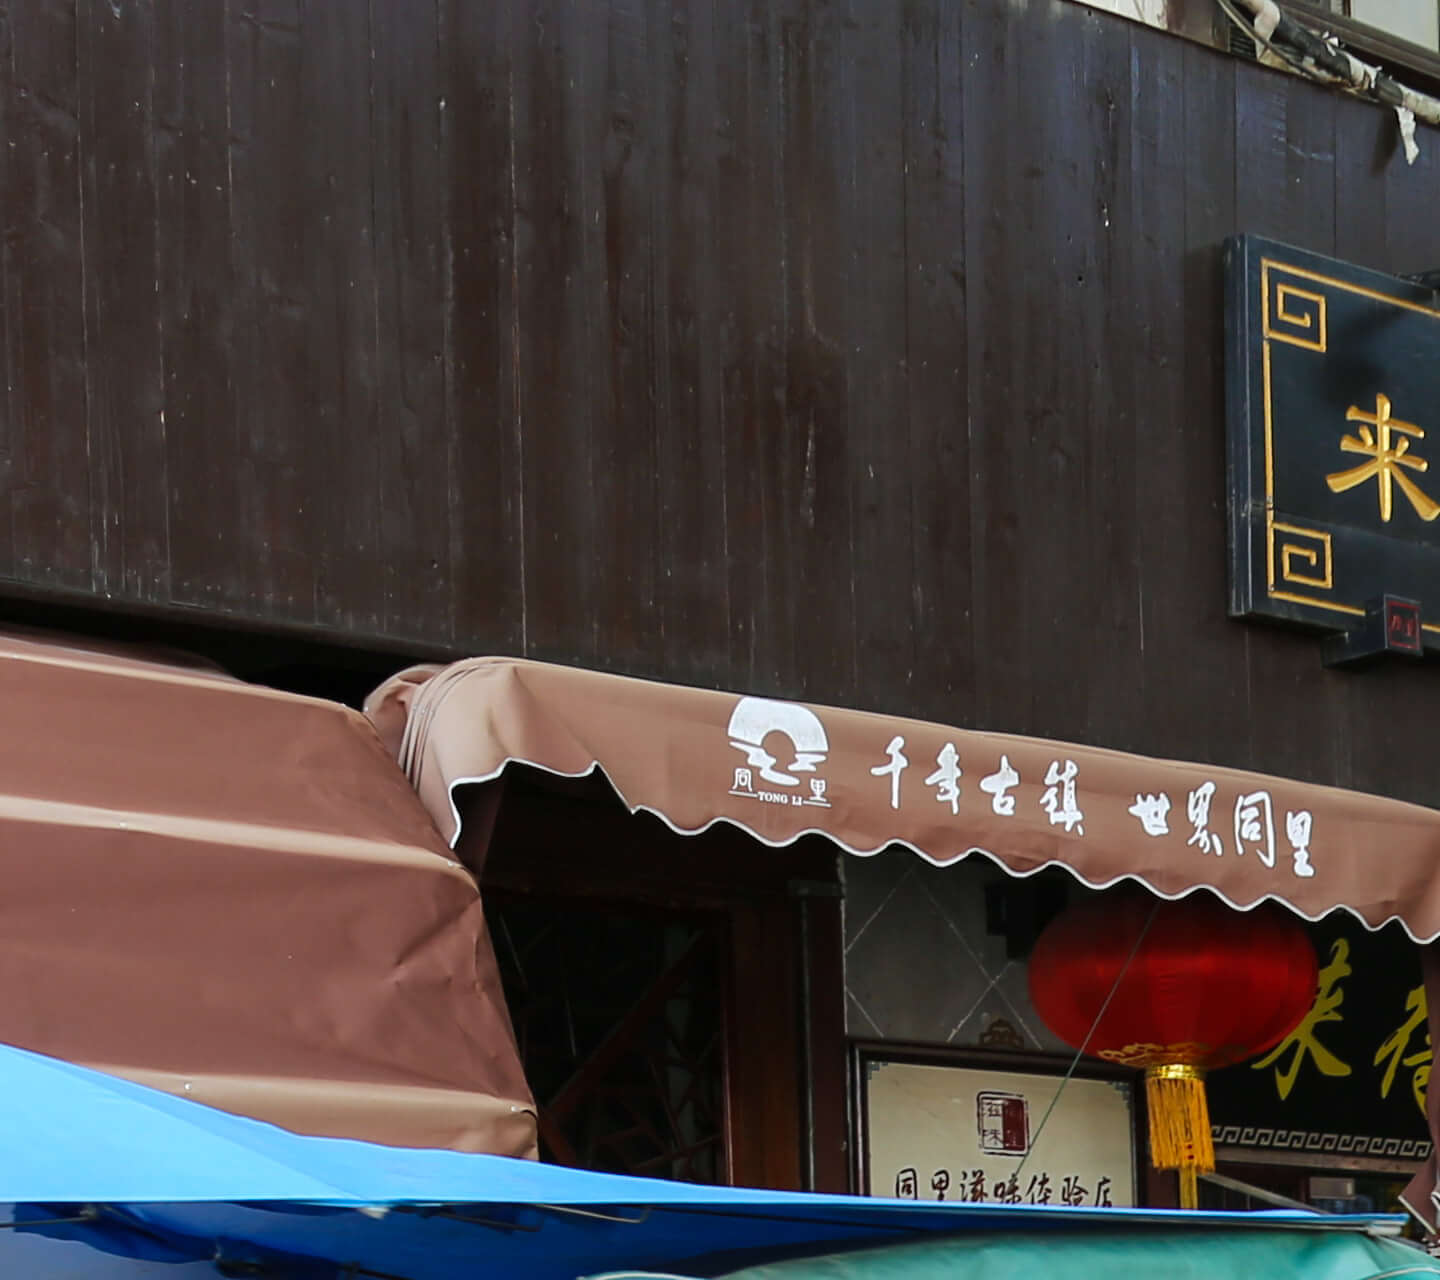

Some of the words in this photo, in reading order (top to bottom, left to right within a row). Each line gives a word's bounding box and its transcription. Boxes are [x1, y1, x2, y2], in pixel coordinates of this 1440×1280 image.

[758, 791, 789, 804] TONG
[1128, 781, 1315, 877] 世界同里
